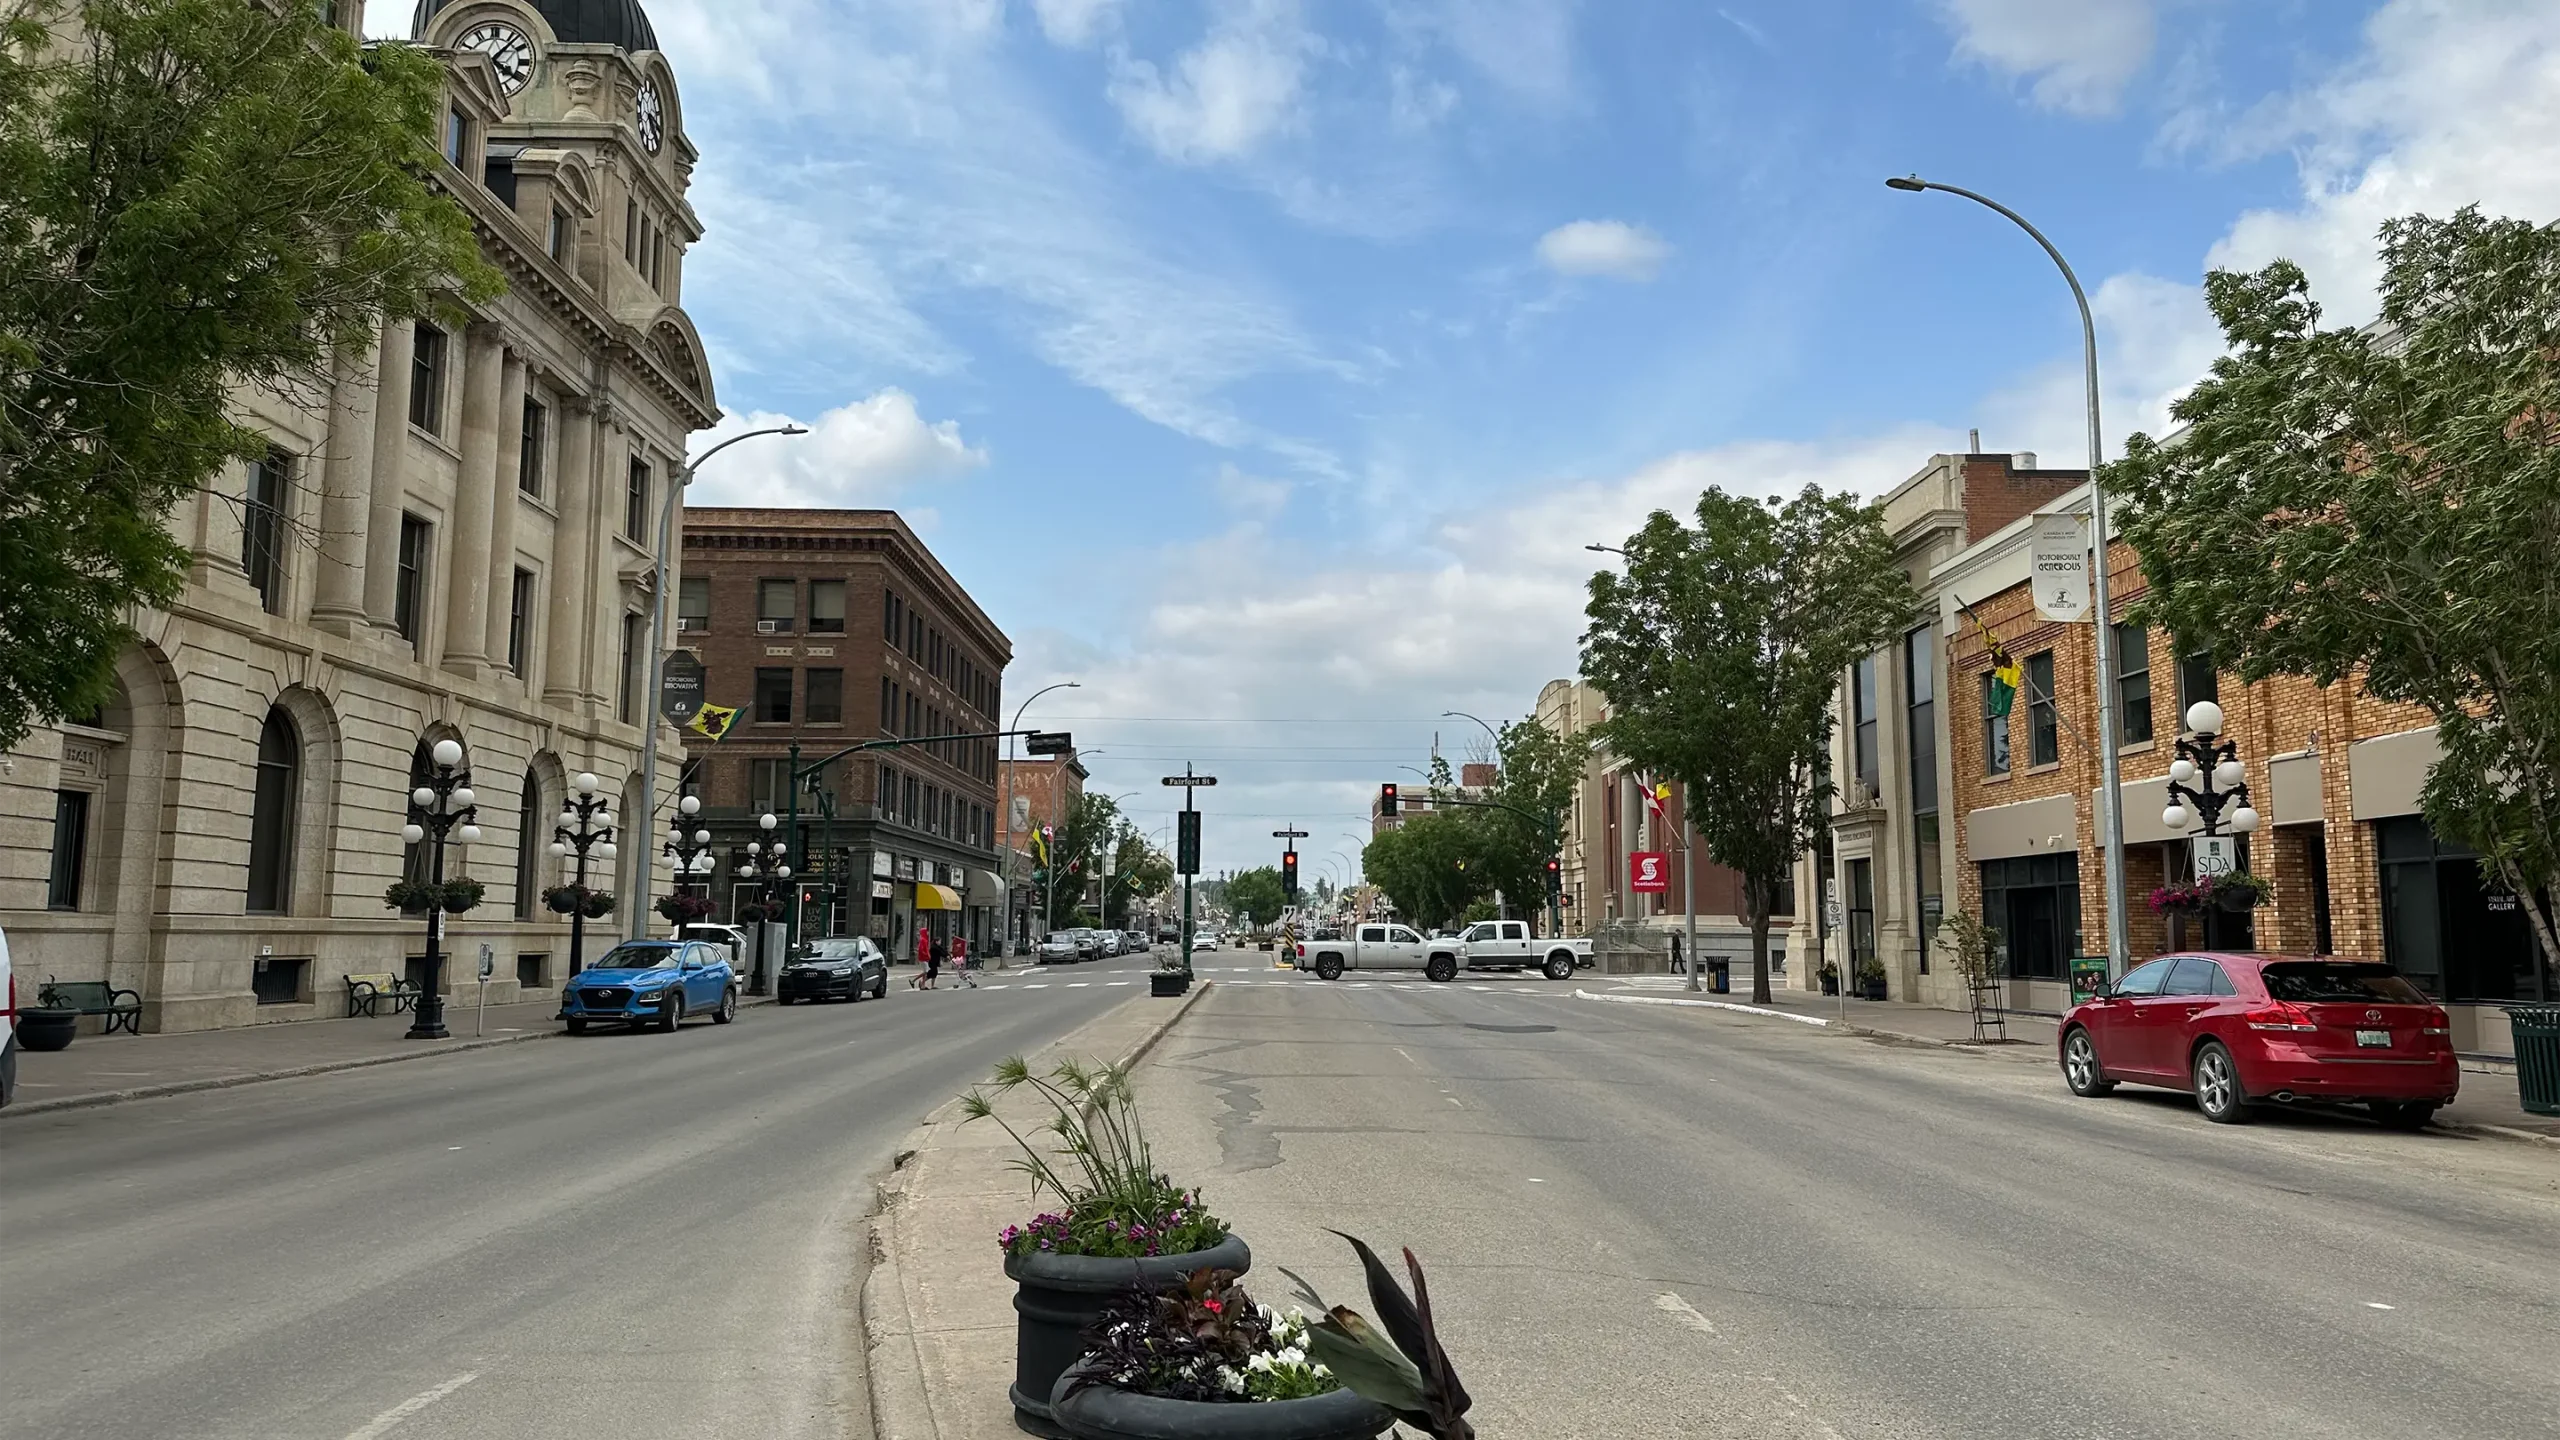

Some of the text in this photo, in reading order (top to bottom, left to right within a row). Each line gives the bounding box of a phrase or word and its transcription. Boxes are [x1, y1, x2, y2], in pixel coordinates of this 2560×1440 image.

[2037, 553, 2081, 561] NOTORIOUSLY
[2038, 562, 2081, 571] GENEROUS
[1169, 778, 1200, 786] Fairford
[2488, 902, 2516, 910] GALLERY
